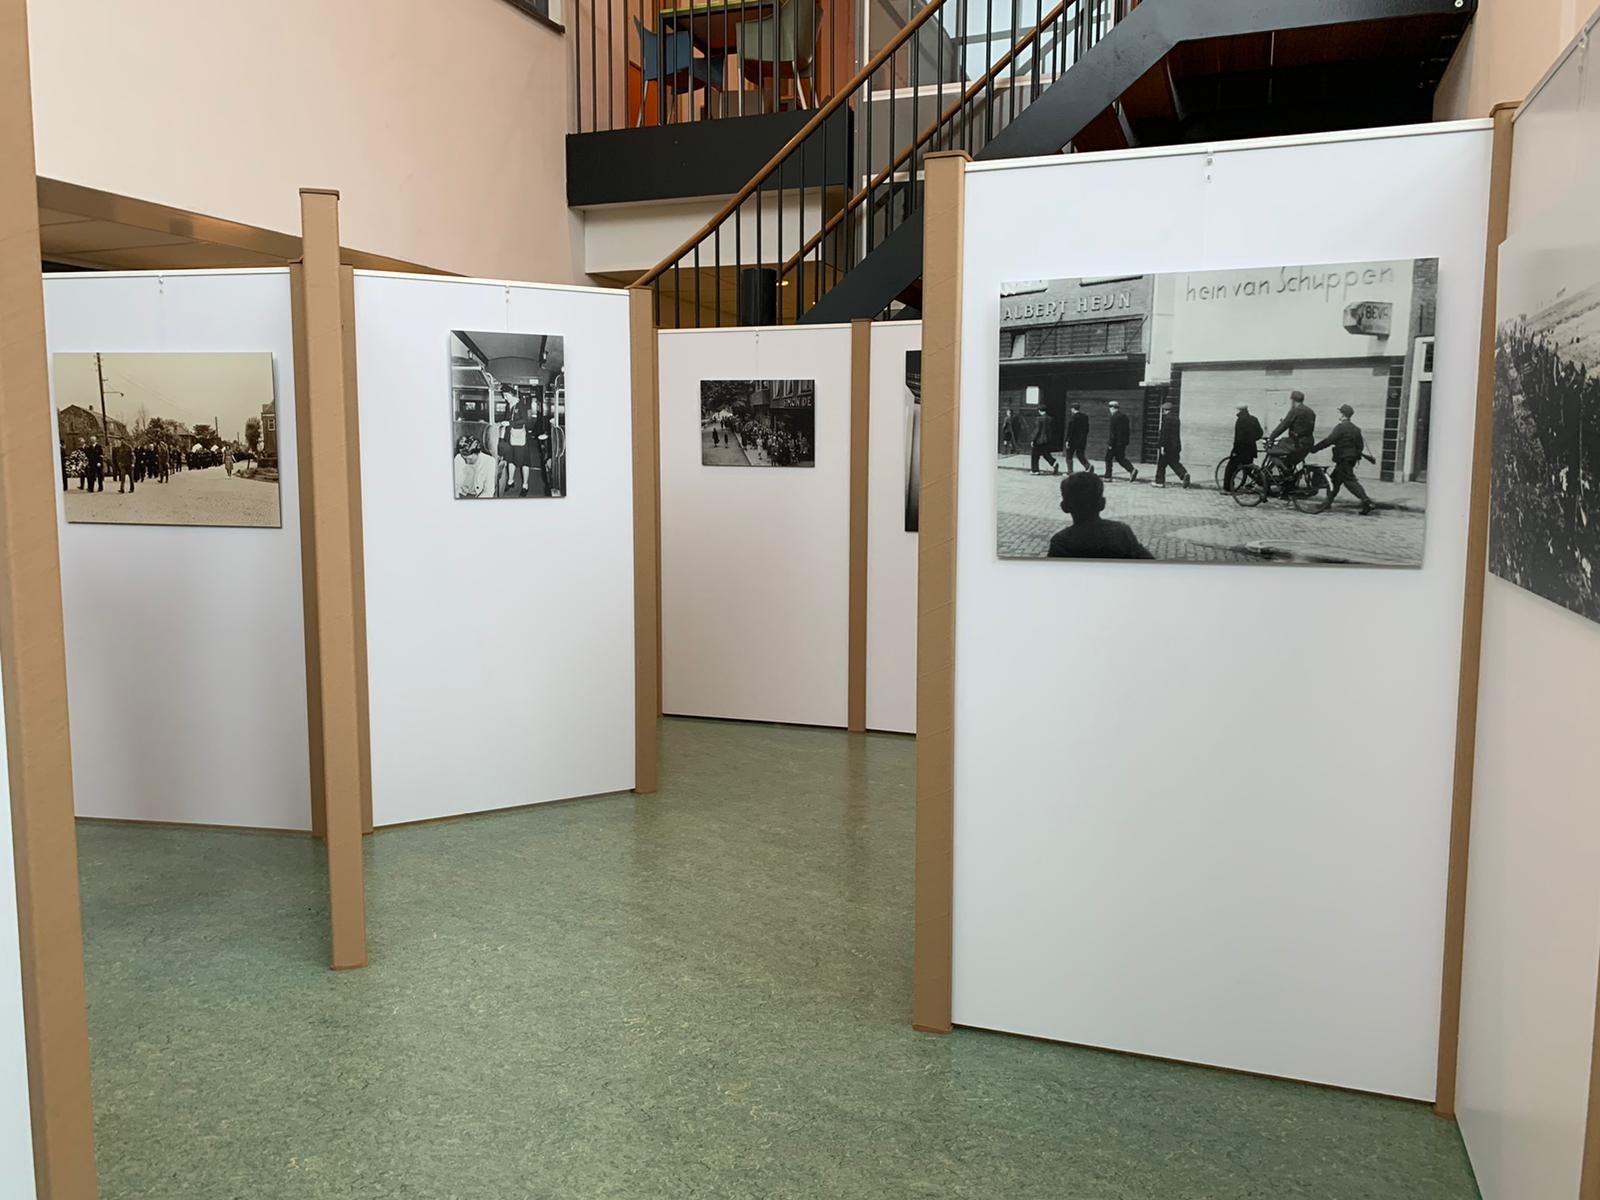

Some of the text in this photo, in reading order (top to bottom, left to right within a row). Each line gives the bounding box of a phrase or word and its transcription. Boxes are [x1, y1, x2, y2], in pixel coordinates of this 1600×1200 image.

[1232, 279, 1270, 297] van
[1276, 266, 1393, 302] Schuppen
[1003, 300, 1068, 321] ALBERT
